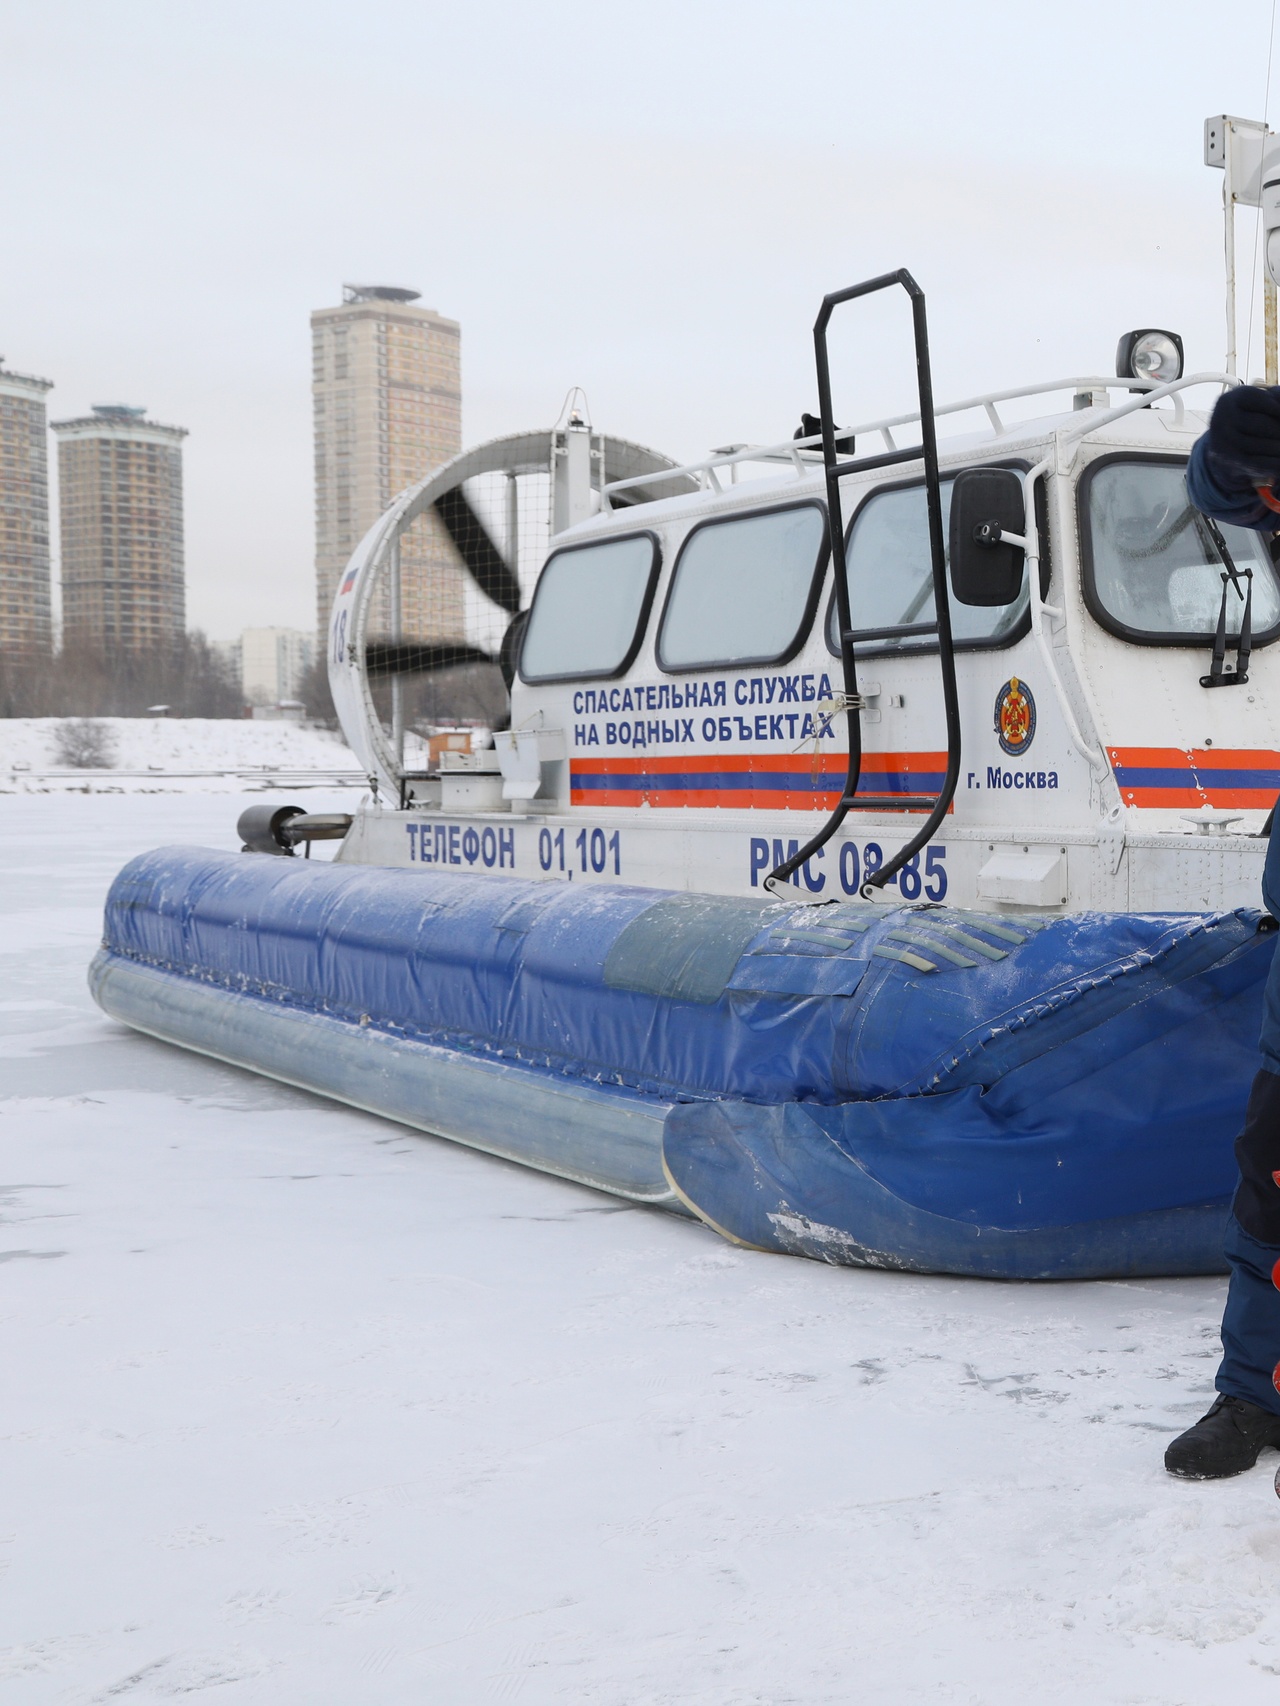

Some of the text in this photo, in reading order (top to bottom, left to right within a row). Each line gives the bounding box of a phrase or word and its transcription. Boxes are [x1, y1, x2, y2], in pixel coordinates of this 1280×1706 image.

[573, 674, 833, 715] СПАСАТЕЛЬНАЯ СЛУЖБА
[575, 712, 835, 748] НА ВОДНЫХ ОБЪЕКТАХ
[967, 766, 1060, 789] г. Москва
[405, 823, 515, 868] ТЕЛЕФОН
